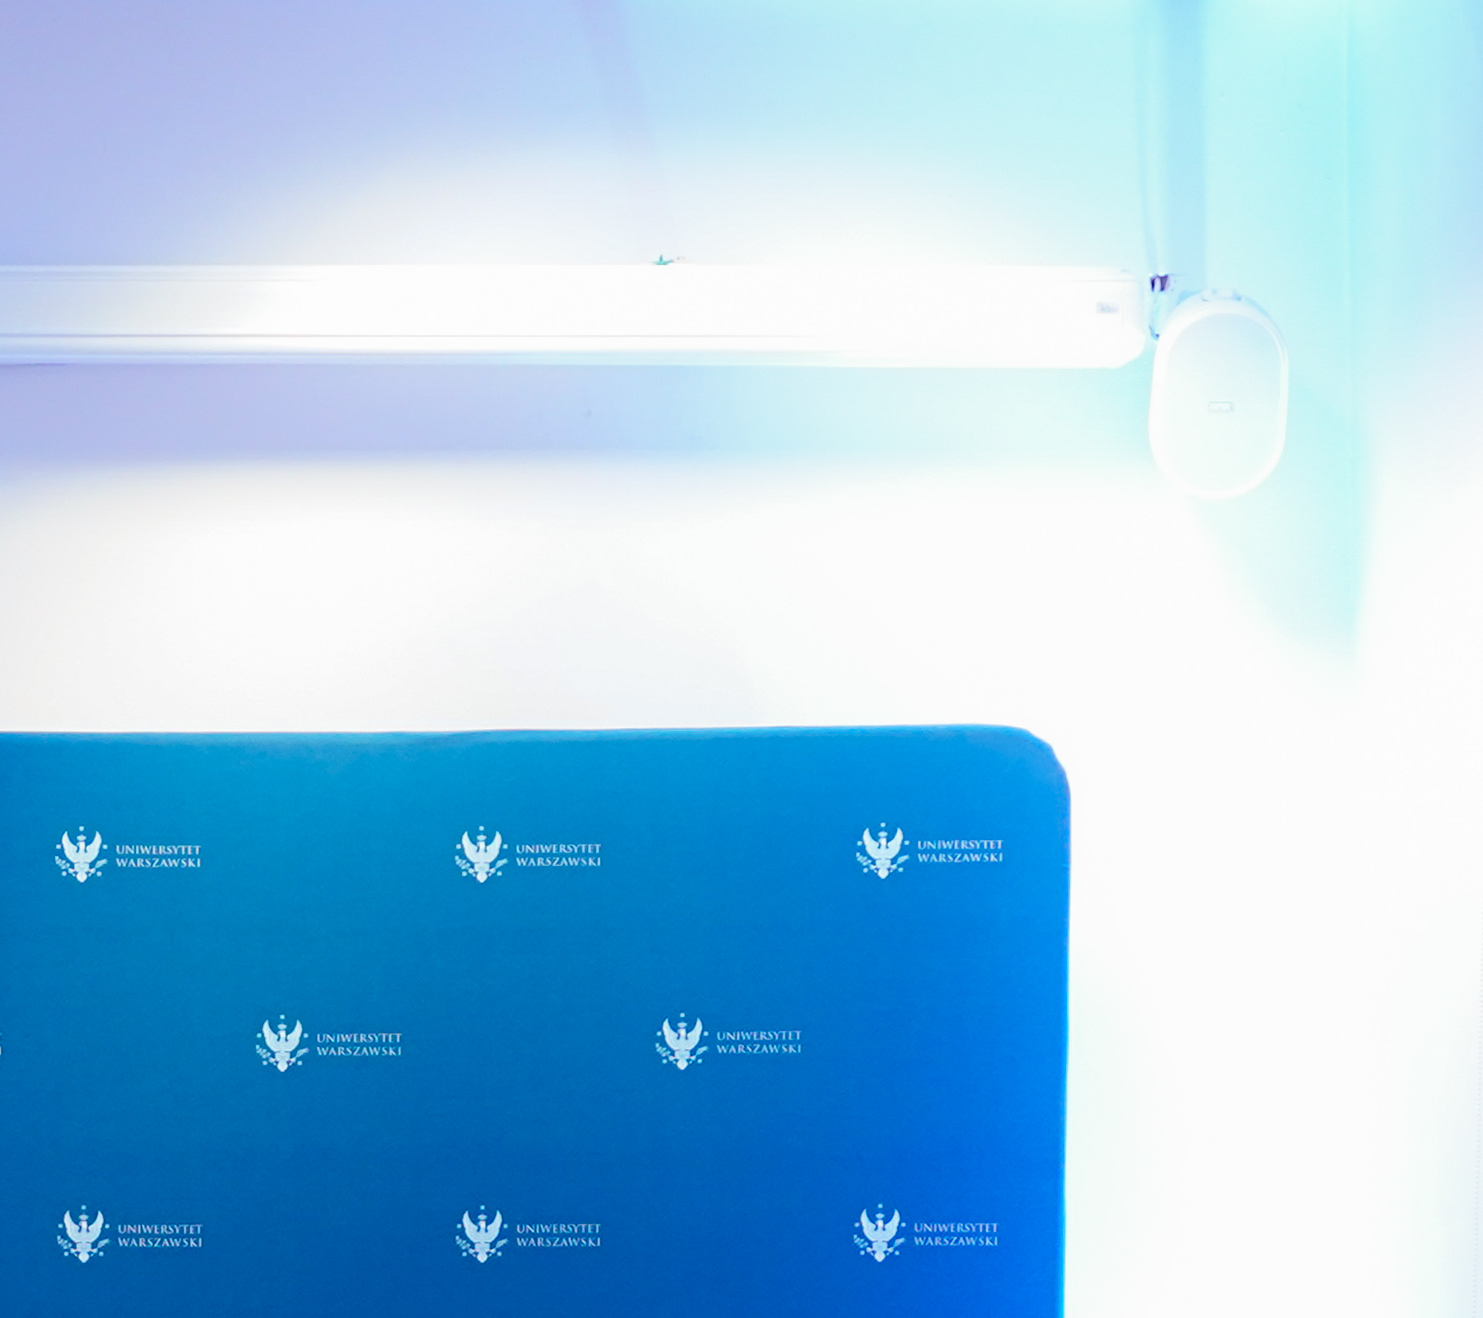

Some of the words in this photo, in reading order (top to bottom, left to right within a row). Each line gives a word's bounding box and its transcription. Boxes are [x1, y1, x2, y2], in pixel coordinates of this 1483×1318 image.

[115, 844, 200, 856] UNIWERSYTET
[515, 843, 602, 854] UNIWERSYTET
[917, 839, 1003, 850] UNIWERSYTET
[115, 857, 201, 868] WARSZAWSKI
[515, 856, 601, 867] WARSZAWSKI
[917, 852, 1003, 863] WARSZAWSKI
[316, 1032, 402, 1044] UNIWERSYTET
[716, 1030, 801, 1041] UNIWERSYTET
[316, 1046, 402, 1057] WARSZAWSKI
[716, 1043, 802, 1054] WARSZAWSKI
[117, 1224, 202, 1235] UNIWERSYTET
[516, 1223, 601, 1234] UNIWERSYTET
[913, 1222, 998, 1233] UNIWERSYTET
[117, 1237, 203, 1248] WARSZAWSKI
[516, 1237, 601, 1247] WARSZAWSKI
[914, 1236, 998, 1246] WARSZAWSKI
